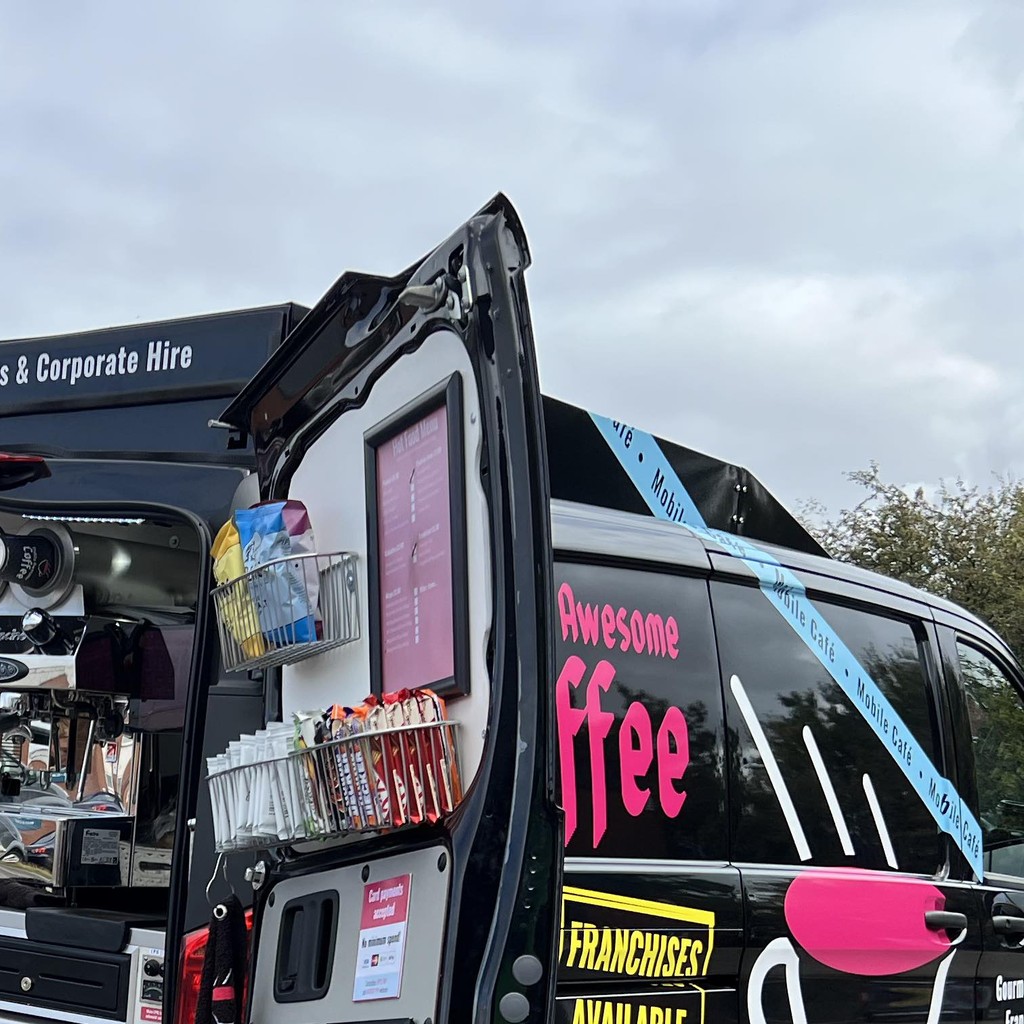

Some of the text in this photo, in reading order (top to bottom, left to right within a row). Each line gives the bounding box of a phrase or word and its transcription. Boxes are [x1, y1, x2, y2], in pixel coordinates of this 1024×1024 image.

[15, 355, 29, 385] &
[36, 346, 139, 386] Corporate
[146, 341, 193, 372] Hire
[650, 467, 687, 524] Mobil
[14, 544, 34, 581] Coffee
[557, 582, 680, 660] Awesome
[810, 618, 835, 663] Café
[856, 677, 912, 767] Mobile Café
[555, 654, 690, 849] ffee
[927, 777, 980, 859] Mobile Café
[566, 920, 704, 978] FRANCHISES
[996, 974, 1024, 1002] Gourm
